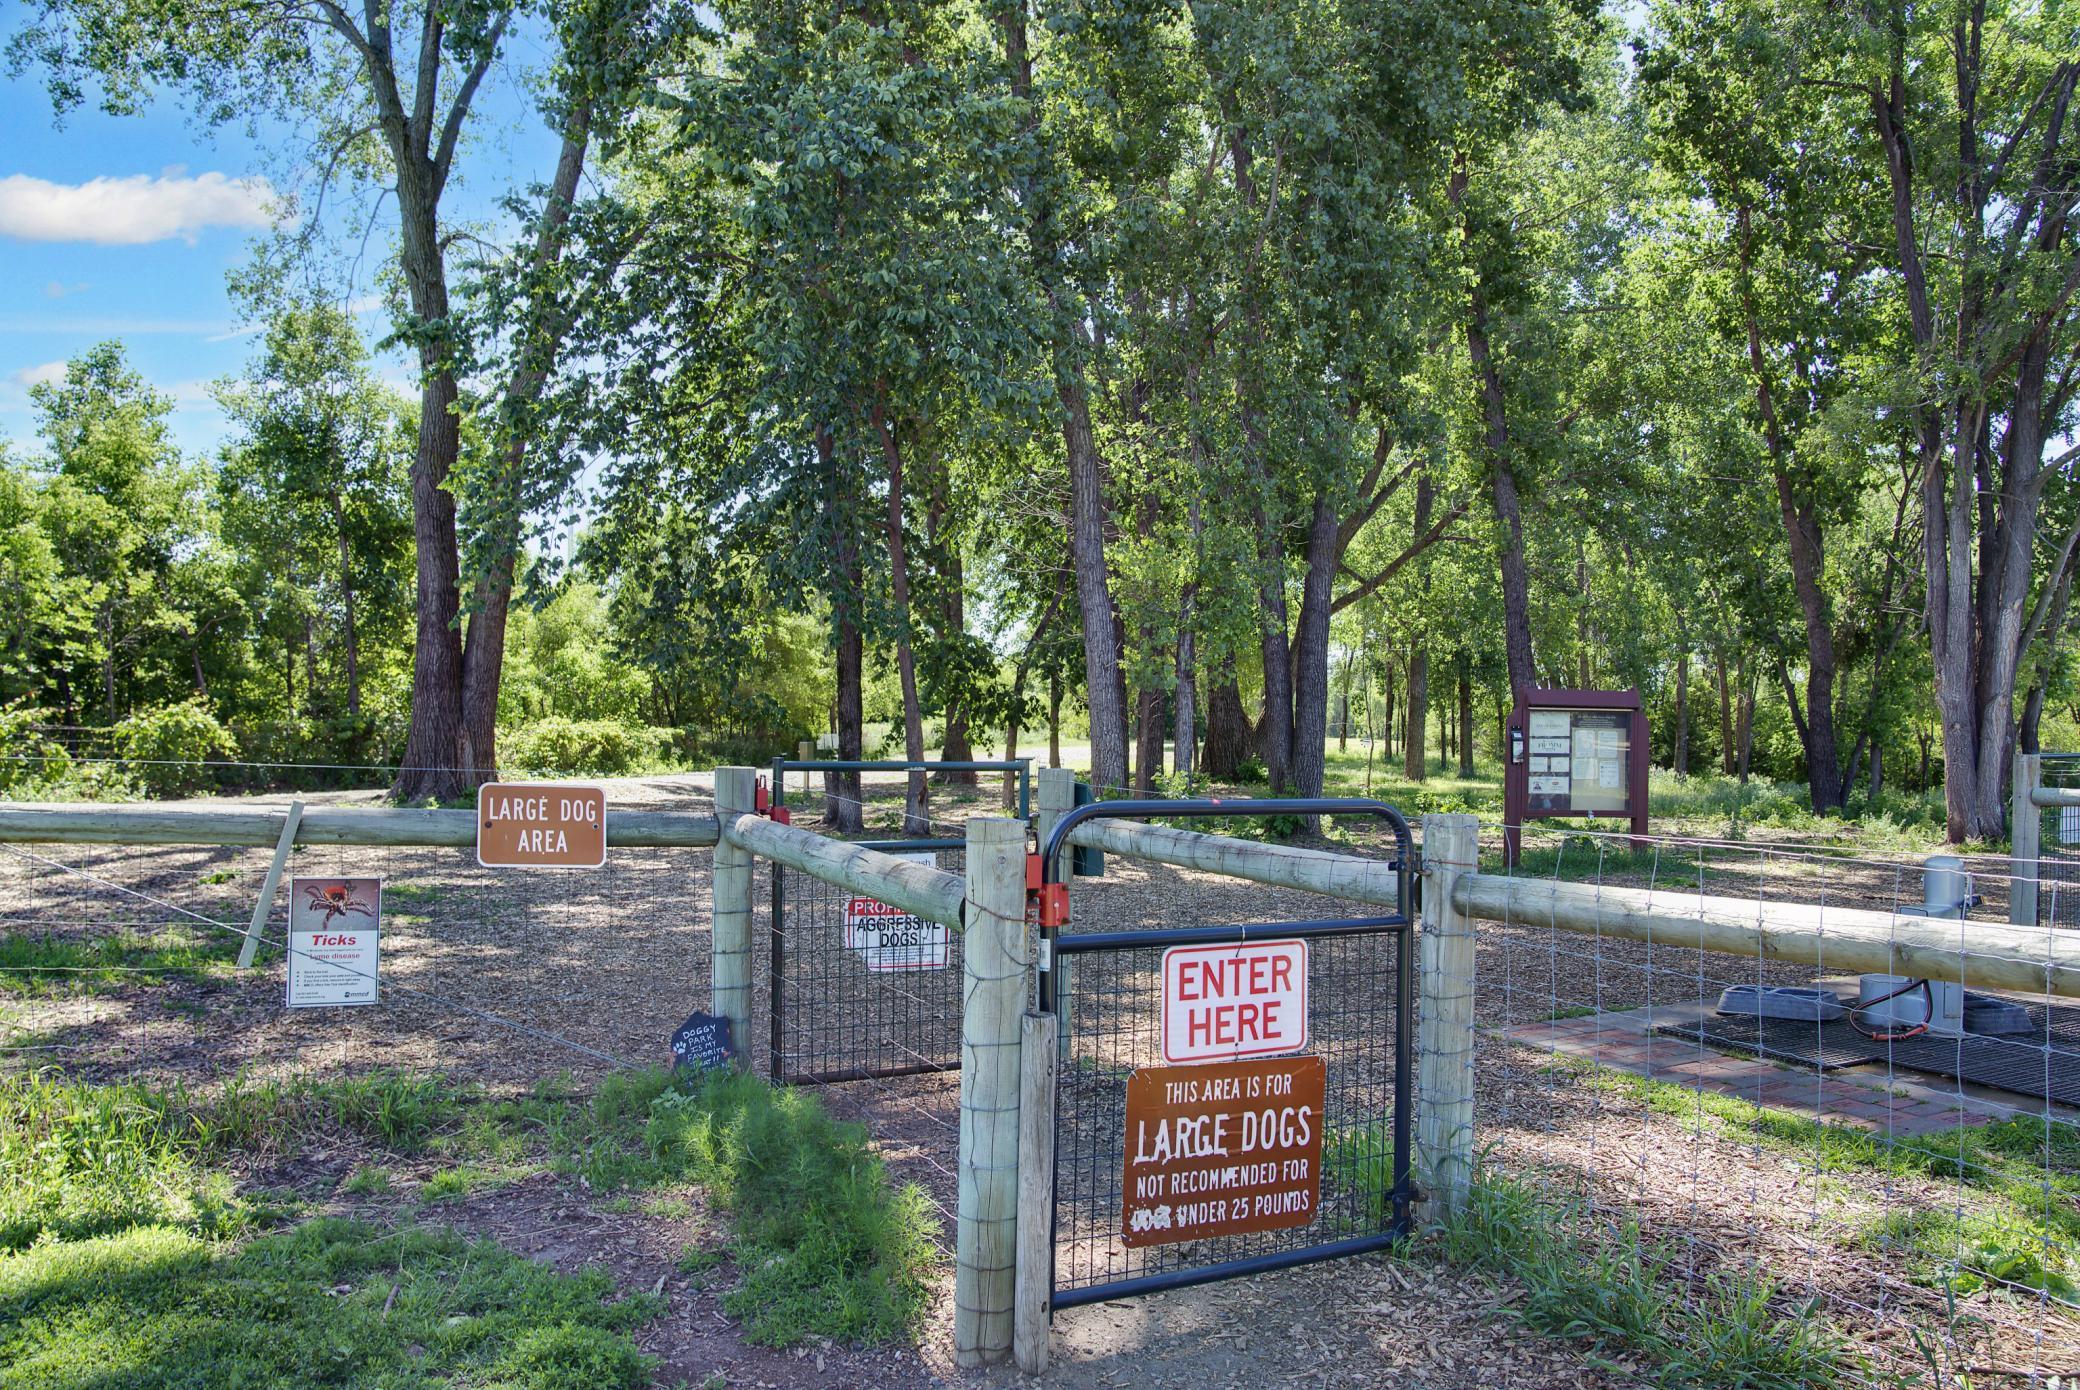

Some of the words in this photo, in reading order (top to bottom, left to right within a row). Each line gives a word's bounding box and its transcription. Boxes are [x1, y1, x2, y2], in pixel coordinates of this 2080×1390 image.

[488, 797, 549, 821] LARGE
[560, 799, 597, 822] DOG
[517, 829, 568, 853] AREA
[312, 934, 357, 946] Ticks
[880, 932, 918, 947] DOGS
[331, 952, 361, 960] disease
[1178, 955, 1292, 1002] ENTER
[683, 1024, 716, 1039] DOGGY
[1188, 1001, 1282, 1048] HERE
[688, 1033, 713, 1047] PARK
[690, 1045, 703, 1053] IS
[705, 1040, 716, 1049] MY
[687, 1046, 726, 1062] FAVORITE
[1165, 1081, 1198, 1105] THIS
[1201, 1077, 1241, 1102] AREA
[1246, 1075, 1260, 1098] IS
[1265, 1073, 1292, 1096] FOR
[1132, 1113, 1229, 1166] LARGE
[1241, 1105, 1312, 1152] DOGS
[1136, 1174, 1165, 1199] NOT
[1171, 1161, 1277, 1195] RECOMMENDED
[1282, 1158, 1308, 1182] FOR
[1176, 1200, 1226, 1228] UNDER
[1231, 1197, 1249, 1220] 25
[1254, 1189, 1310, 1217] POUNDS
